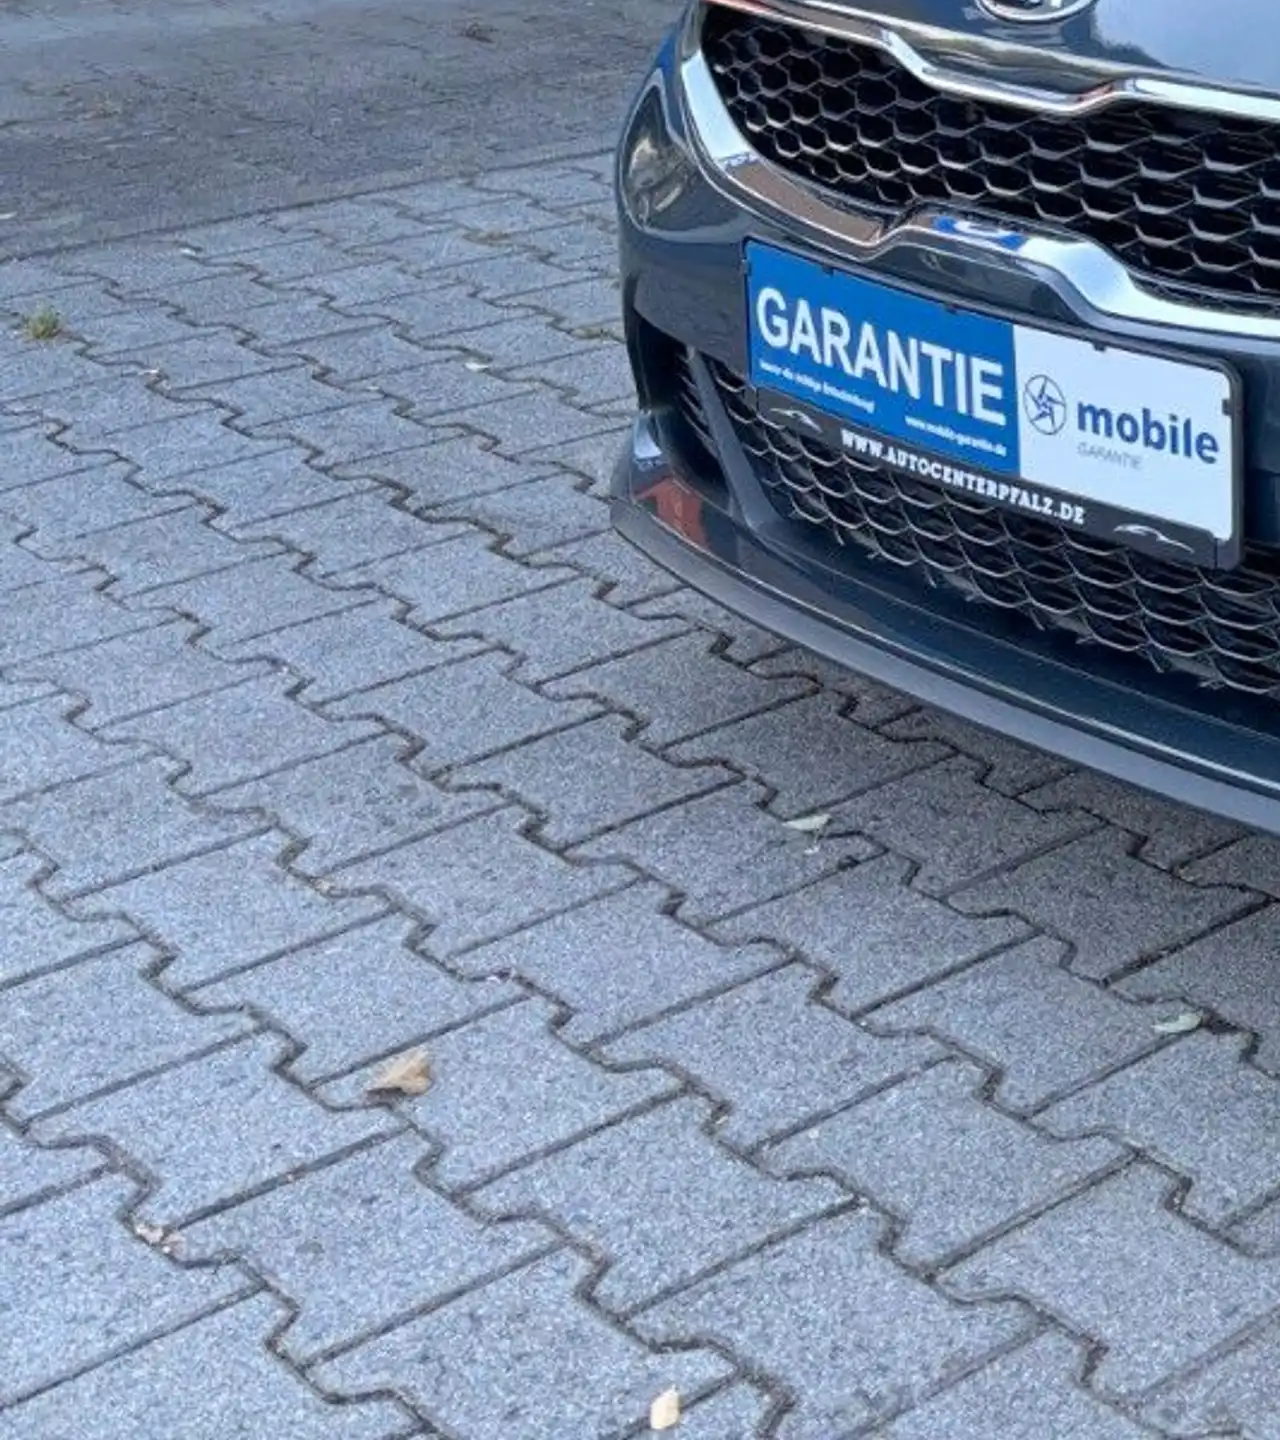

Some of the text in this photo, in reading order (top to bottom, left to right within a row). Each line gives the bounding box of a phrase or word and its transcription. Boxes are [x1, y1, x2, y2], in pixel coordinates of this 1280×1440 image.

[756, 287, 1007, 426] GARANTIE
[1077, 401, 1219, 464] mobile
[1077, 441, 1143, 470] GARANTIE
[840, 428, 1085, 525] WWW.AUTOCENTERPFALZ.DE
